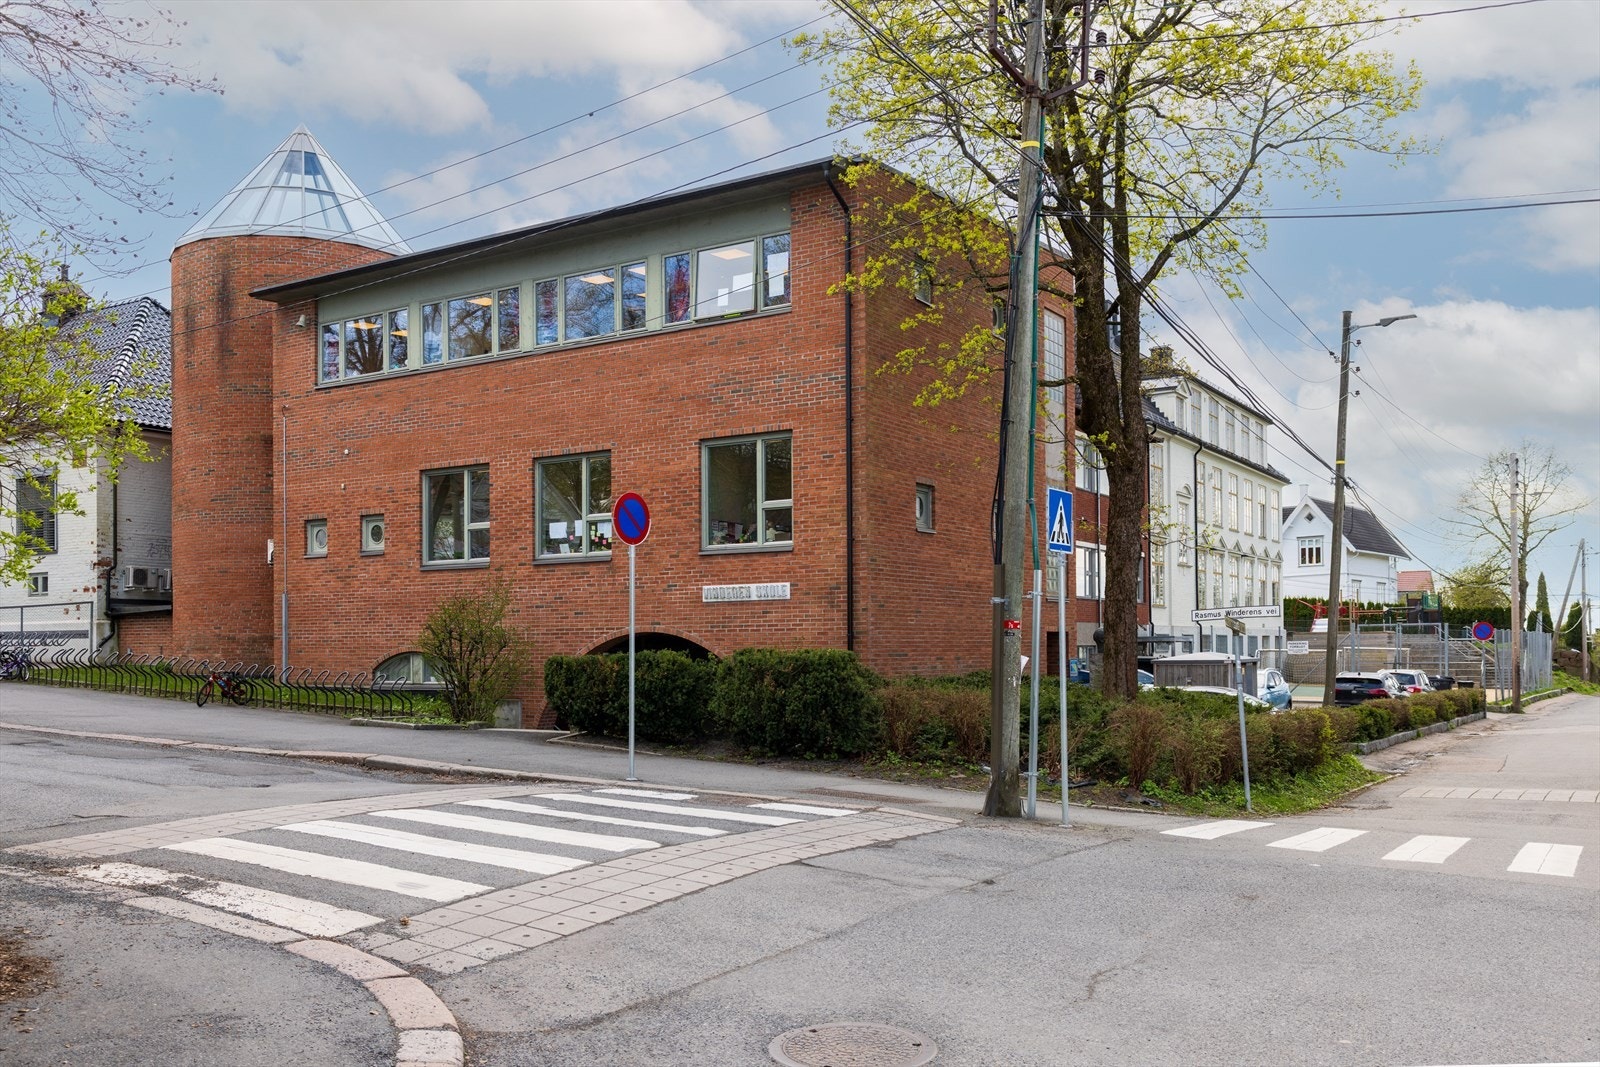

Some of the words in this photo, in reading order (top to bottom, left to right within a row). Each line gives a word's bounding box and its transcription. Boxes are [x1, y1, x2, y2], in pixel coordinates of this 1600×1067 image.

[755, 584, 788, 598] SKOLE
[1194, 611, 1222, 619] Rasmus
[1225, 609, 1262, 617] Winderens
